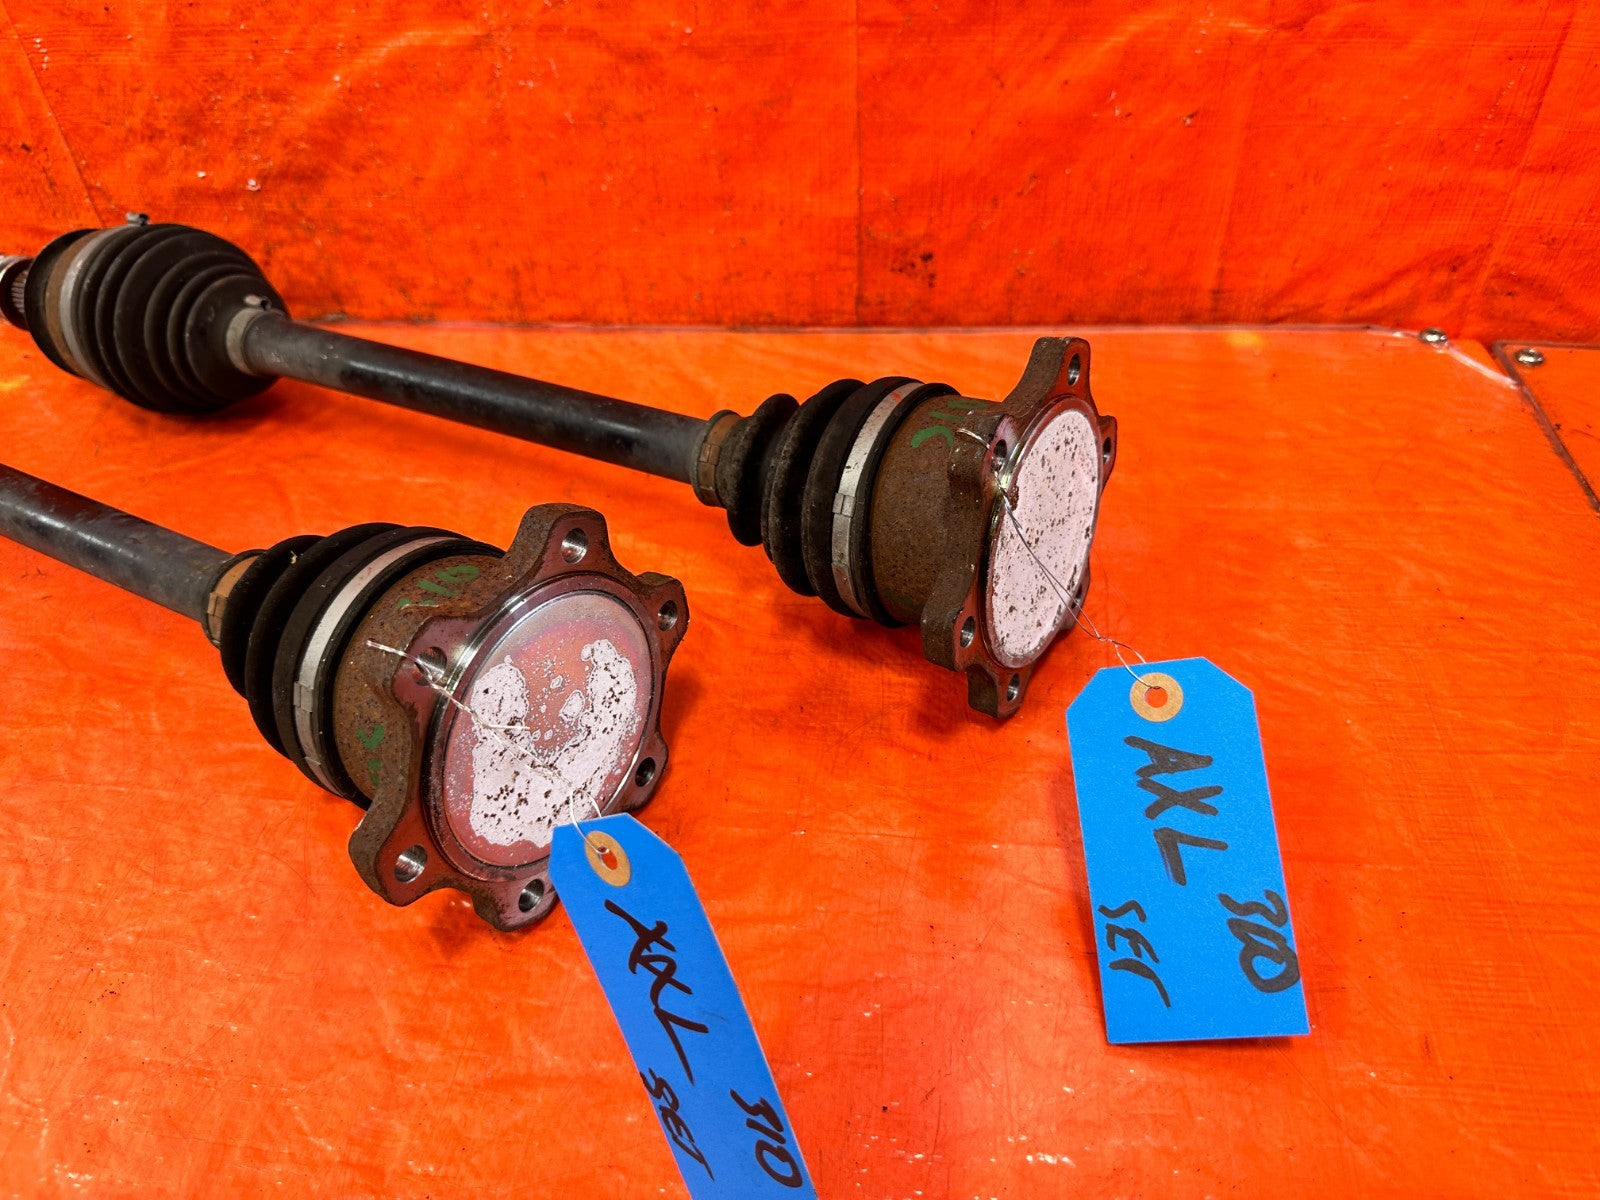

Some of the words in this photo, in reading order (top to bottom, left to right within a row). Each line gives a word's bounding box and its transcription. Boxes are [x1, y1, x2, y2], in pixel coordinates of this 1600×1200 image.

[1123, 735, 1229, 887] AXL
[1097, 899, 1172, 1009] SET
[639, 1066, 716, 1182] SET
[729, 1088, 804, 1189] 310
